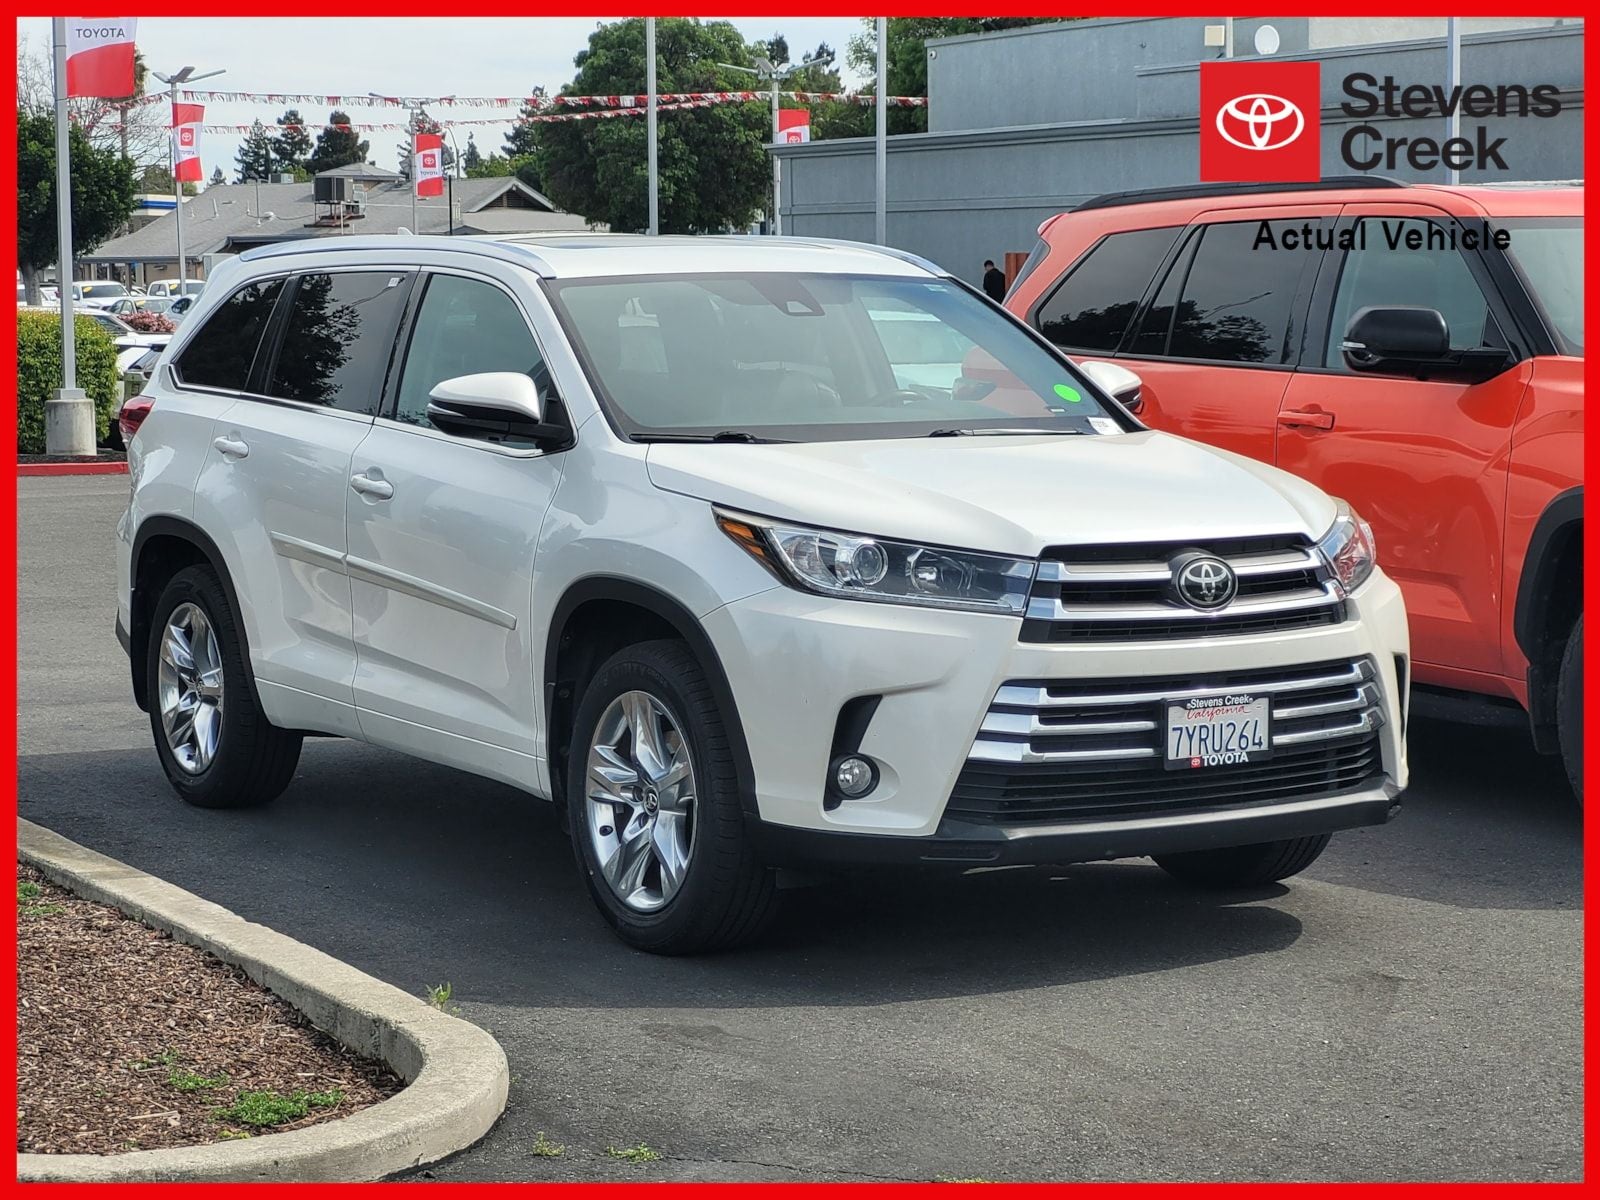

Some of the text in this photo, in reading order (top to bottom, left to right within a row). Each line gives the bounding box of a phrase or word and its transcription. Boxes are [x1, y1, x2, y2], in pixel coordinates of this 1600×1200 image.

[76, 28, 125, 38] TOYOTA
[1190, 694, 1250, 709] Stevens Creek
[1187, 705, 1252, 721] California
[1172, 719, 1263, 758] 7YRU264
[1202, 752, 1249, 767] TOYOTA
